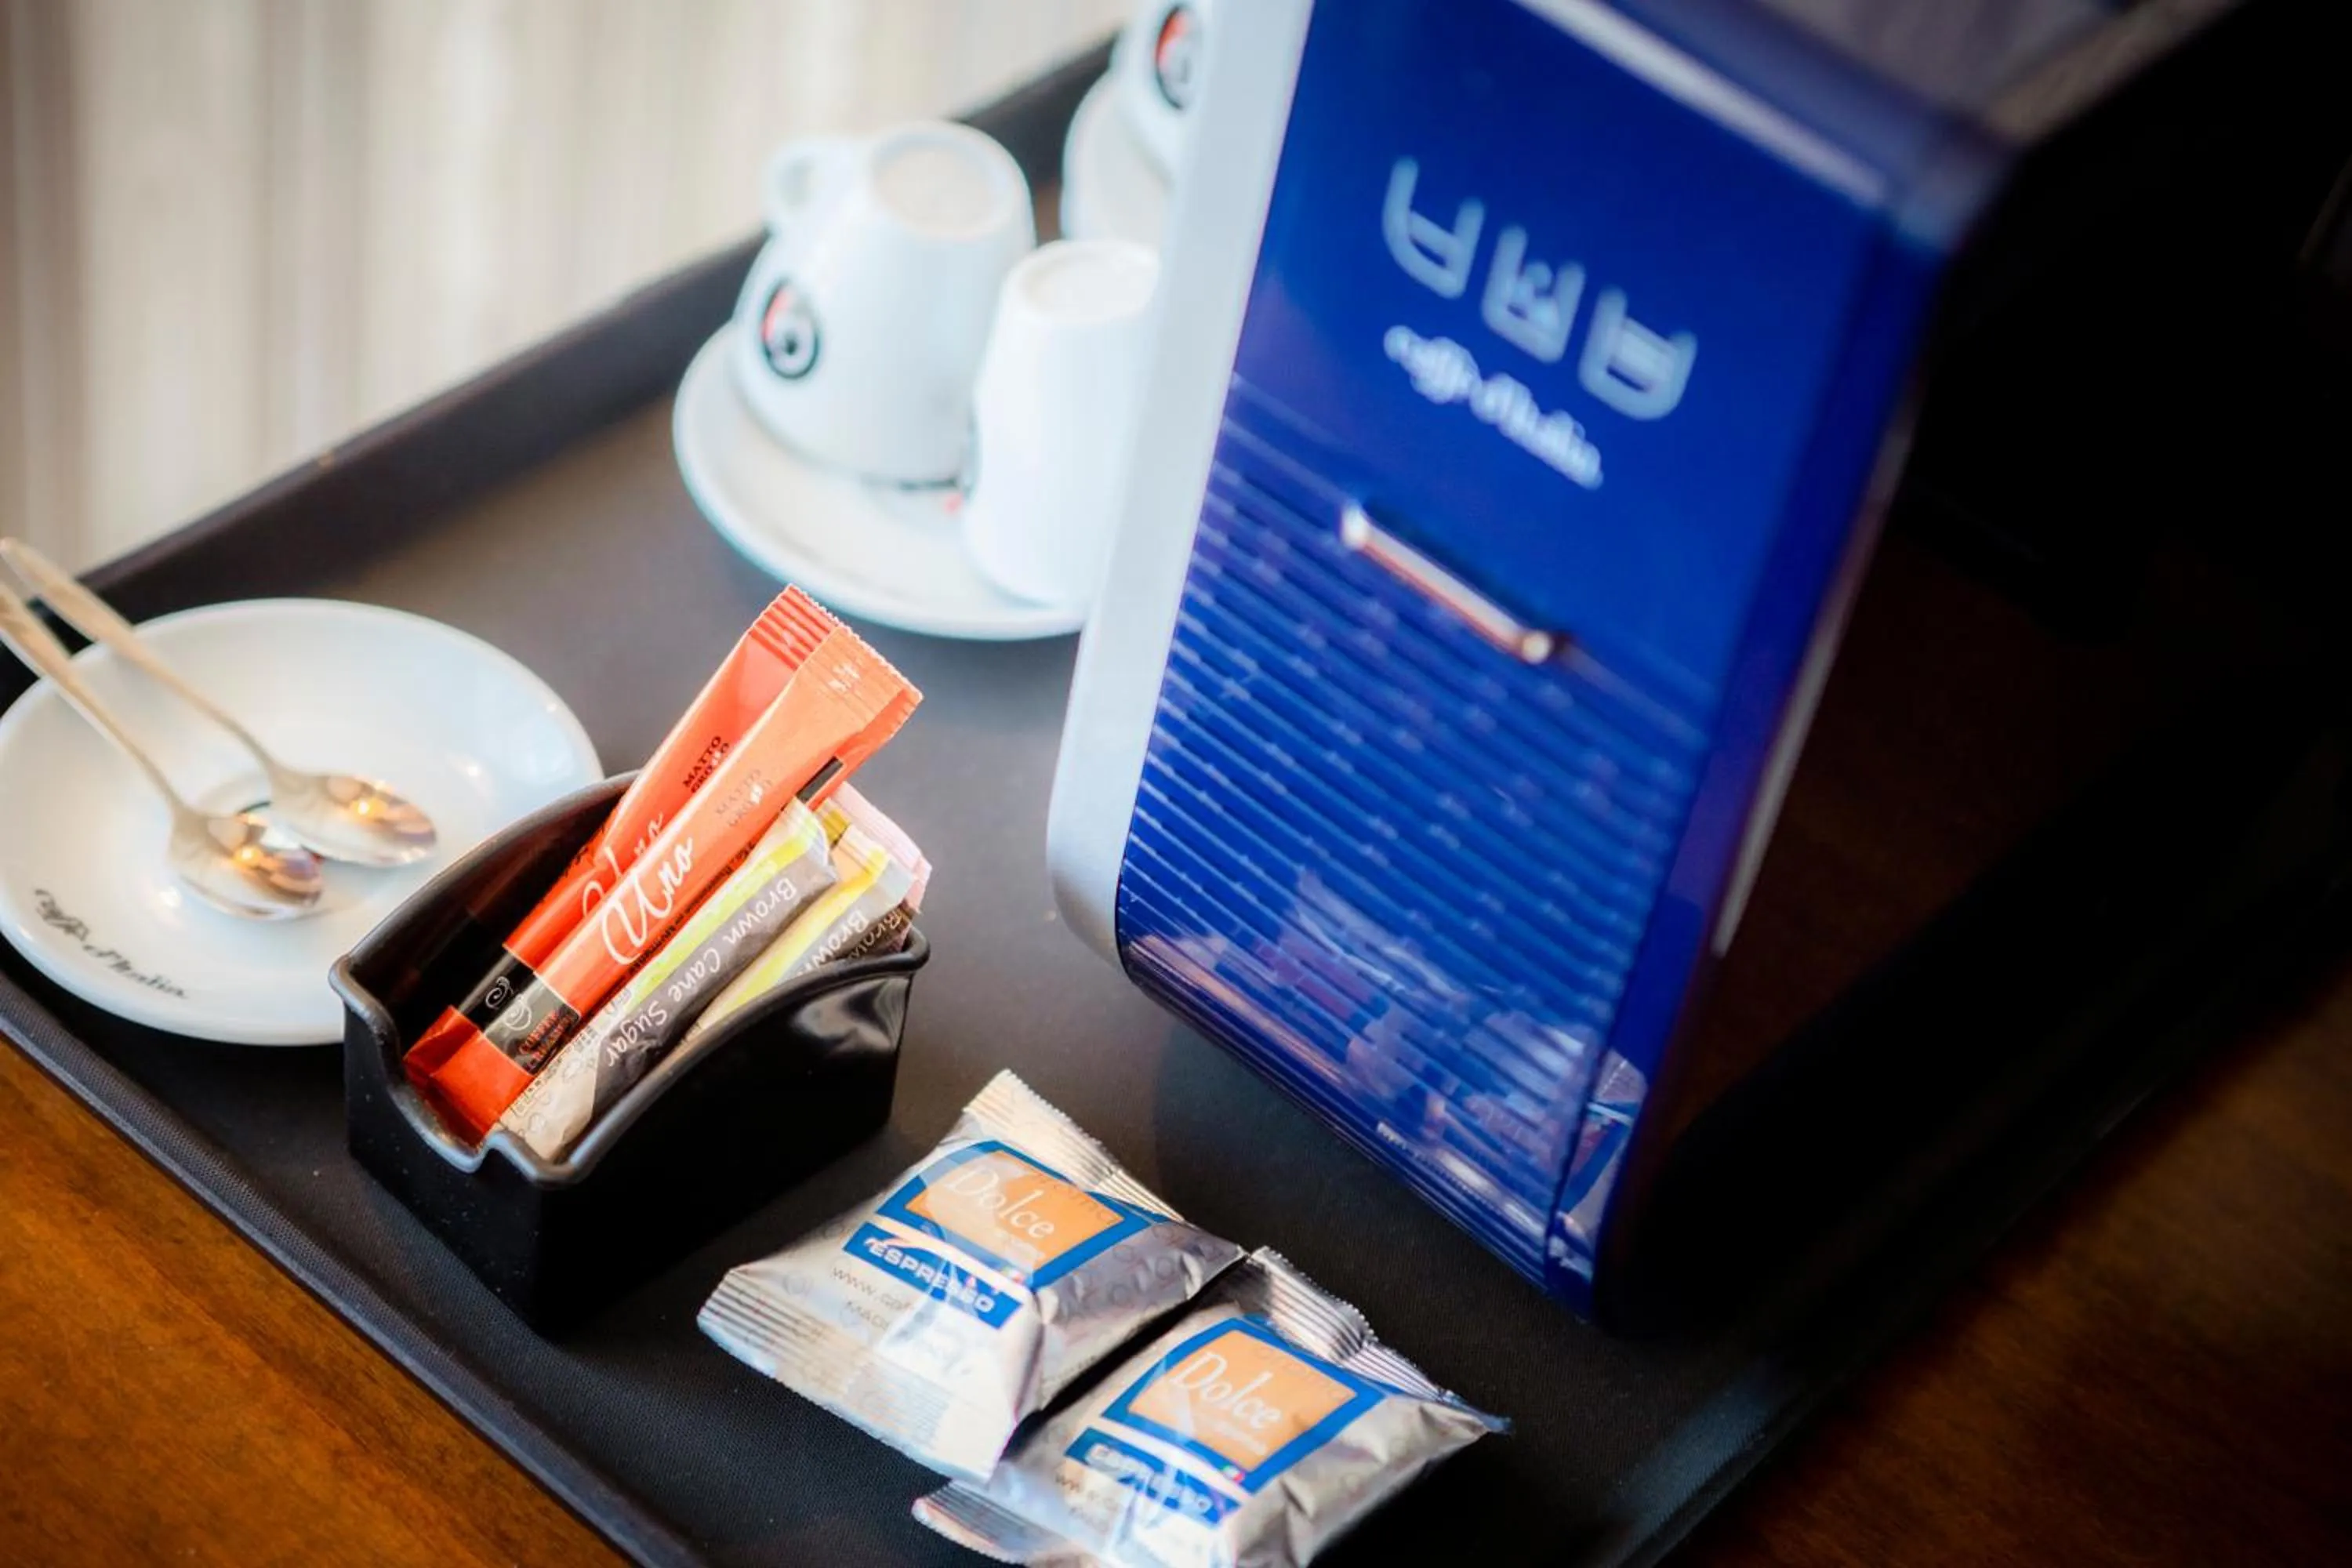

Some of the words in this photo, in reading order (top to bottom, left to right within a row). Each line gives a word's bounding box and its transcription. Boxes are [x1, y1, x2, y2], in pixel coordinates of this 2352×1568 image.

[683, 735, 722, 789] MATTO
[601, 837, 694, 965] Uno
[723, 877, 797, 946] Brown
[668, 947, 720, 1002] Cane
[607, 1000, 667, 1067] Sugar
[942, 1163, 1055, 1239] Dolce
[1170, 1351, 1283, 1429] Dolce
